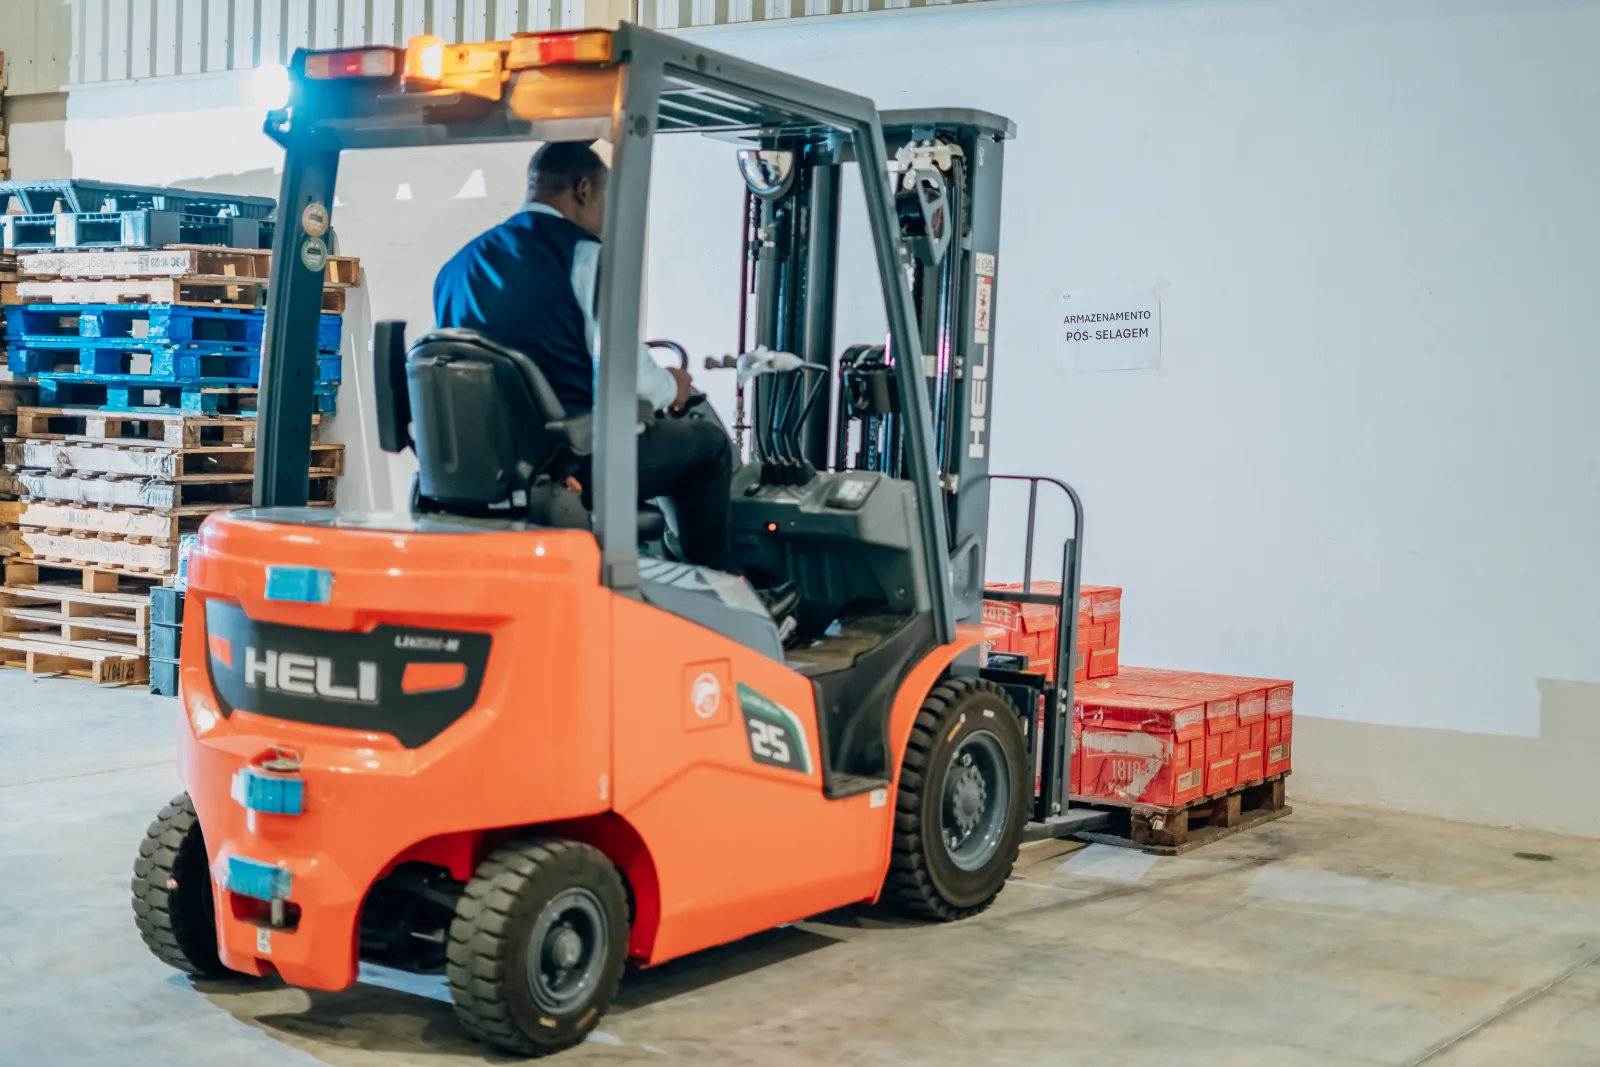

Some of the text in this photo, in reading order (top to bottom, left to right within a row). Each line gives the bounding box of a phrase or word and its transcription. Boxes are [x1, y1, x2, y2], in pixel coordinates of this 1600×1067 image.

[1063, 310, 1151, 324] ARMAZENAMENTO
[1095, 327, 1149, 340] SELAGEM
[968, 330, 988, 458] HELI
[245, 646, 379, 703] HELI
[749, 719, 790, 763] 25
